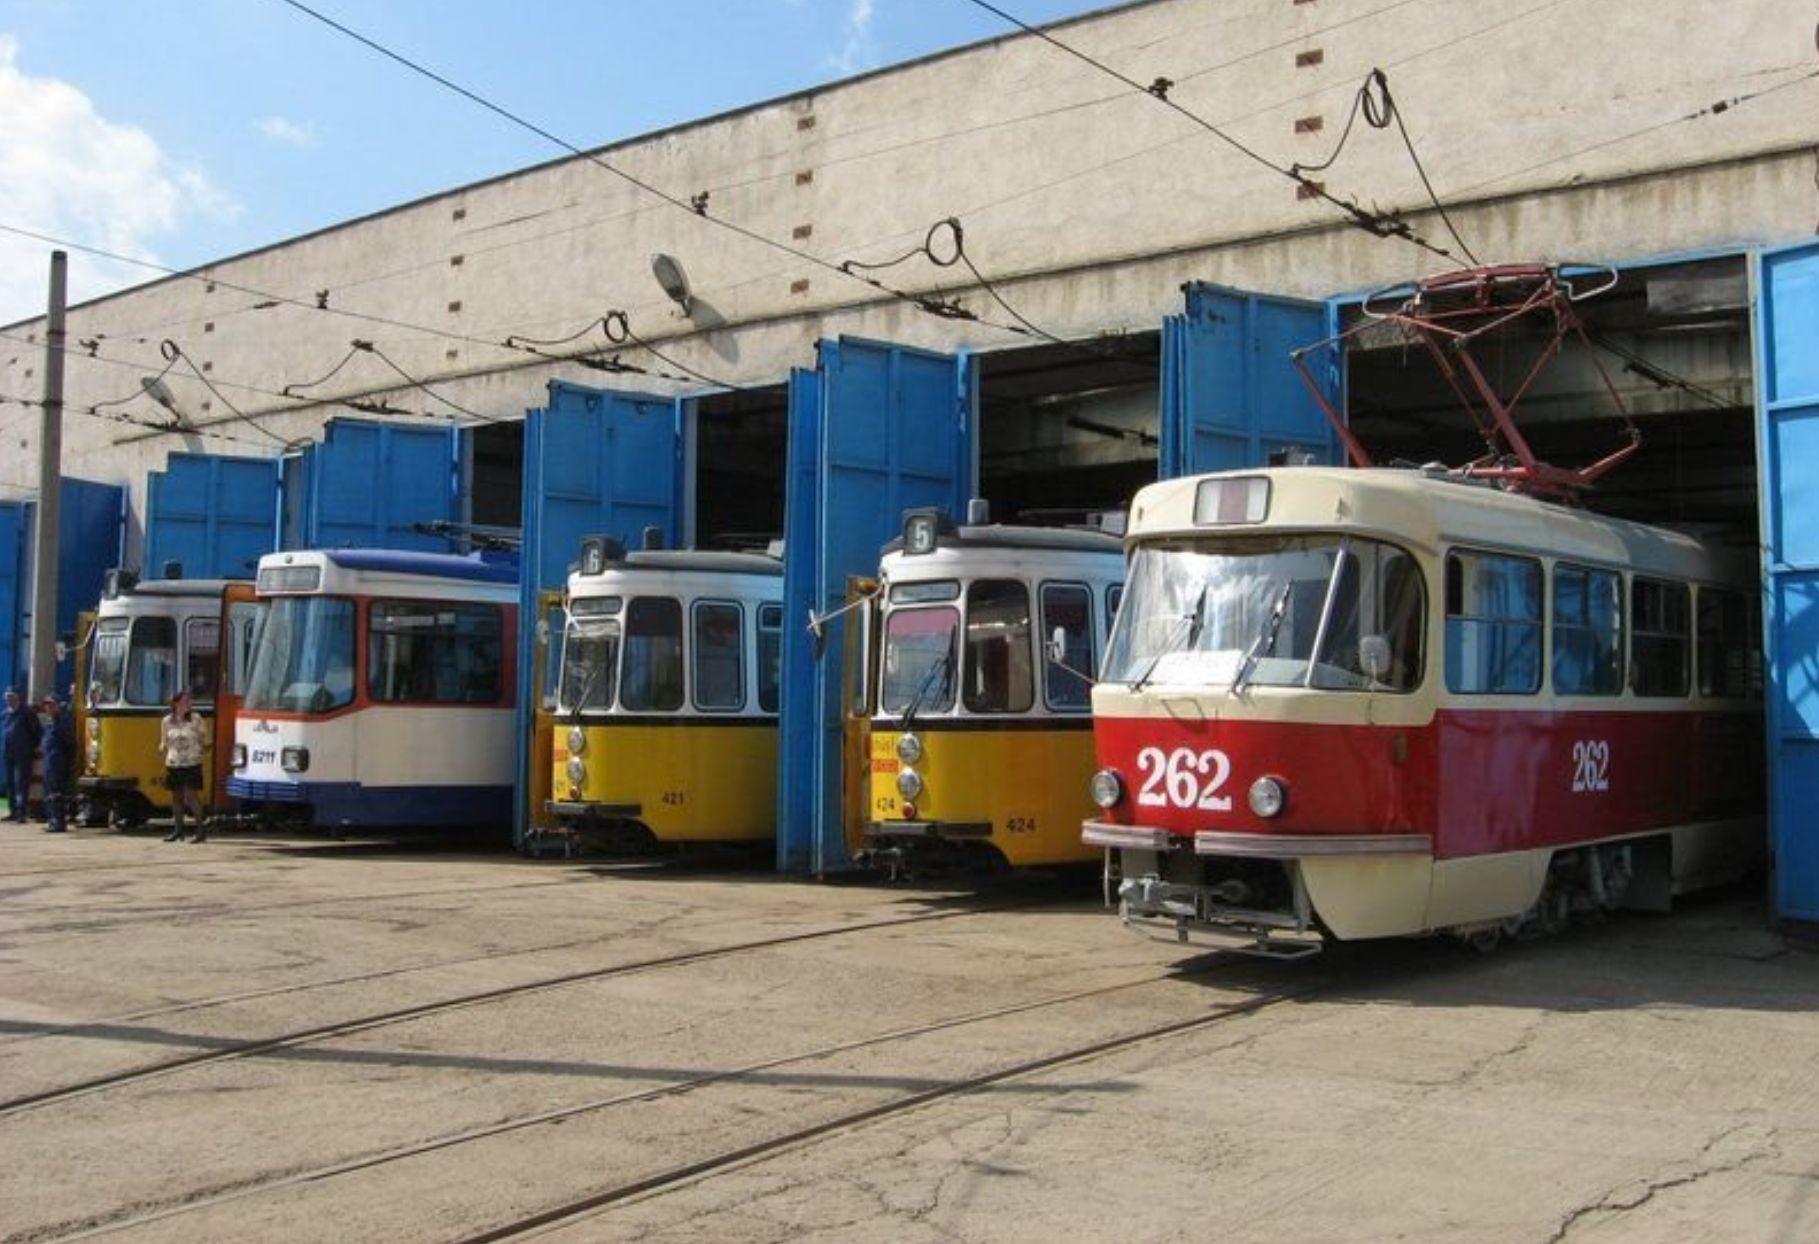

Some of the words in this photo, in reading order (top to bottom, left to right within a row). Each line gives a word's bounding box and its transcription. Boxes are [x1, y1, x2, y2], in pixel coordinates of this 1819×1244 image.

[914, 521, 929, 550] 5
[588, 548, 599, 573] 6
[1137, 746, 1232, 811] 262
[1571, 740, 1609, 792] 262
[659, 790, 684, 805] 421
[1006, 817, 1035, 833] 424
